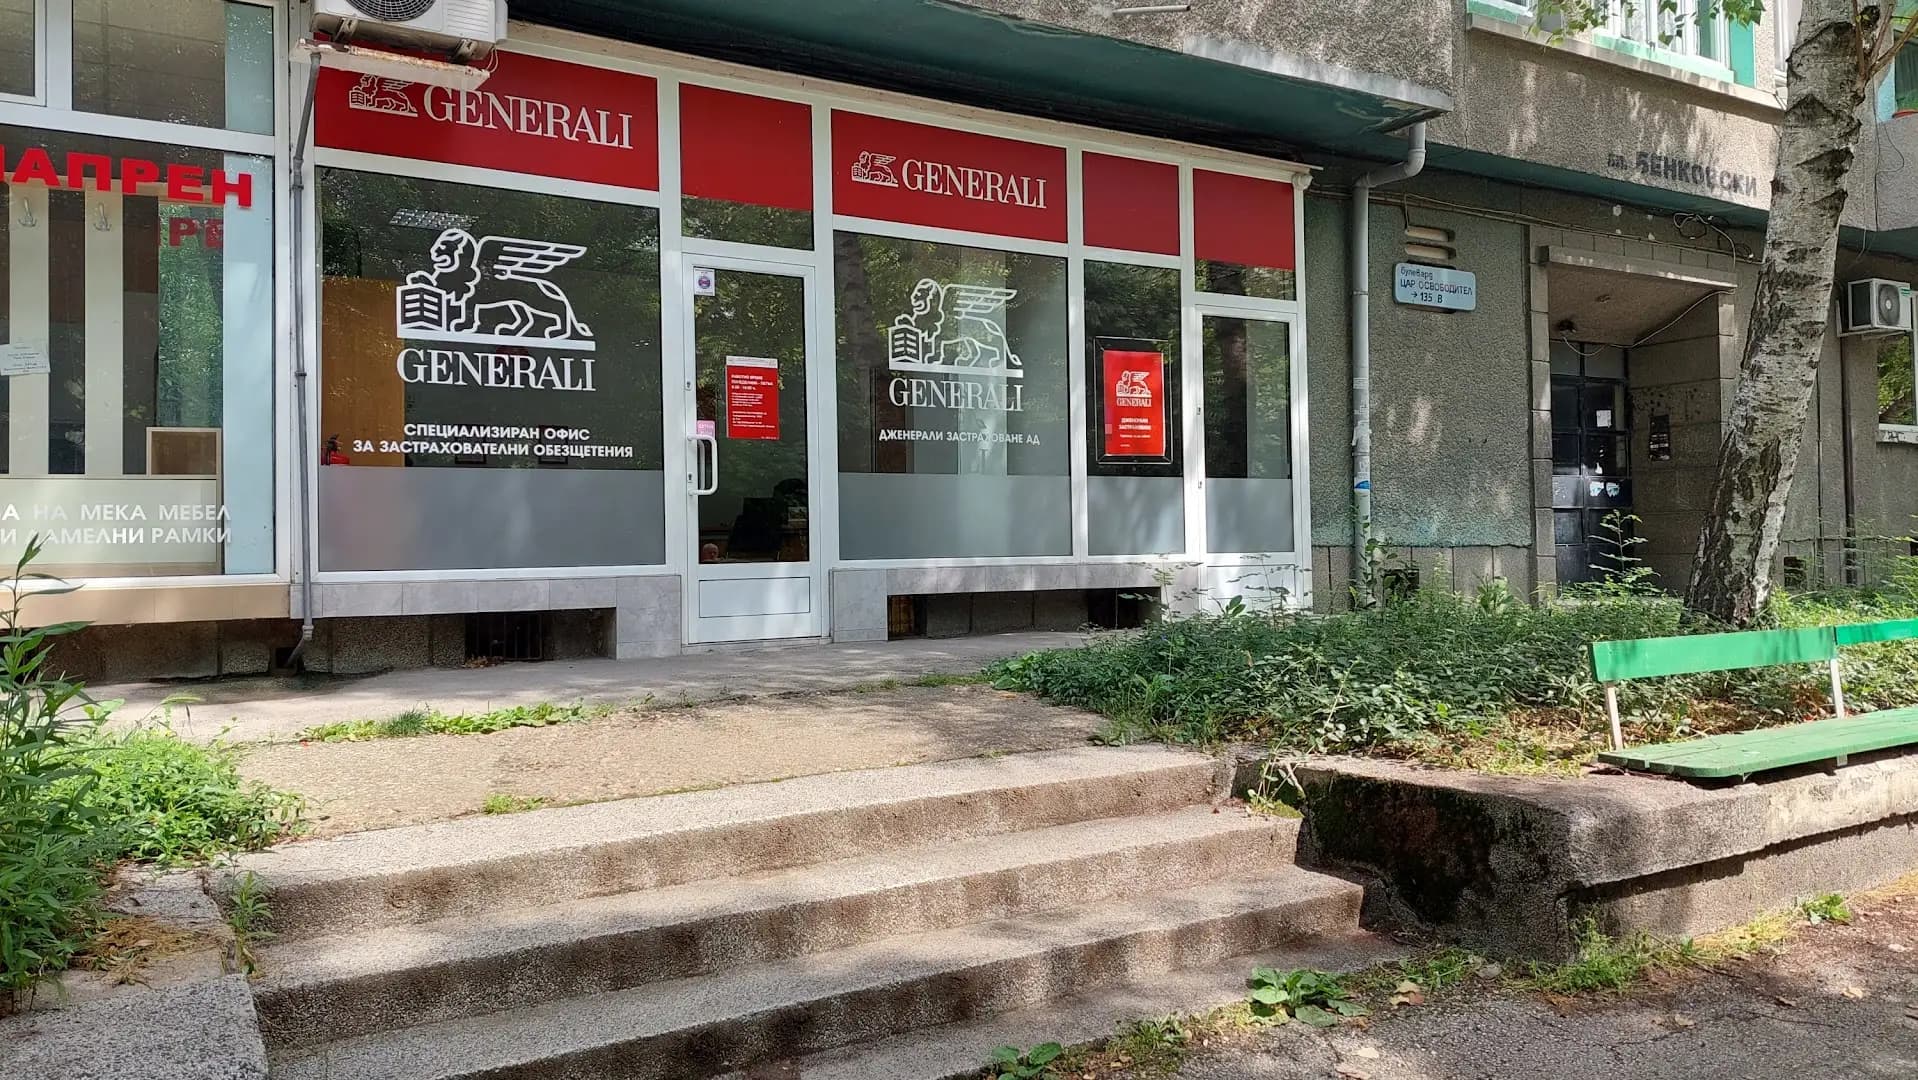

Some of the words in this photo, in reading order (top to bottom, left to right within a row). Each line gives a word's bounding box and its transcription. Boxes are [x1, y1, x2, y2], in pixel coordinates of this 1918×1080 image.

[422, 84, 634, 149] GENERALI
[901, 158, 1048, 209] GENERALI
[1400, 279, 1416, 289] ЦАР
[1418, 280, 1473, 296] ОСВОБОДИТЕЛ
[1420, 292, 1433, 302] 135
[396, 348, 596, 392] GENERALI
[888, 377, 1024, 412] GENERALI
[403, 423, 540, 440] СПЕЦИАЛИЗИРАН
[544, 428, 590, 442] ОФИС
[878, 428, 943, 442] ДЖЕНЕРАЛИ
[946, 431, 1023, 444] ЗАСТРАХОВАНЕ
[1025, 434, 1041, 446] АД
[353, 440, 374, 453] ЗА
[379, 440, 529, 457] ЗАСТРАХОВАТЕЛНИ
[533, 444, 633, 459] ОБЕЗЩЕТЕНИЯ
[34, 504, 68, 521] НА
[80, 504, 147, 521] МЕКА
[159, 504, 231, 521] МЕБЕЛ
[151, 527, 231, 544] РАМКИ
